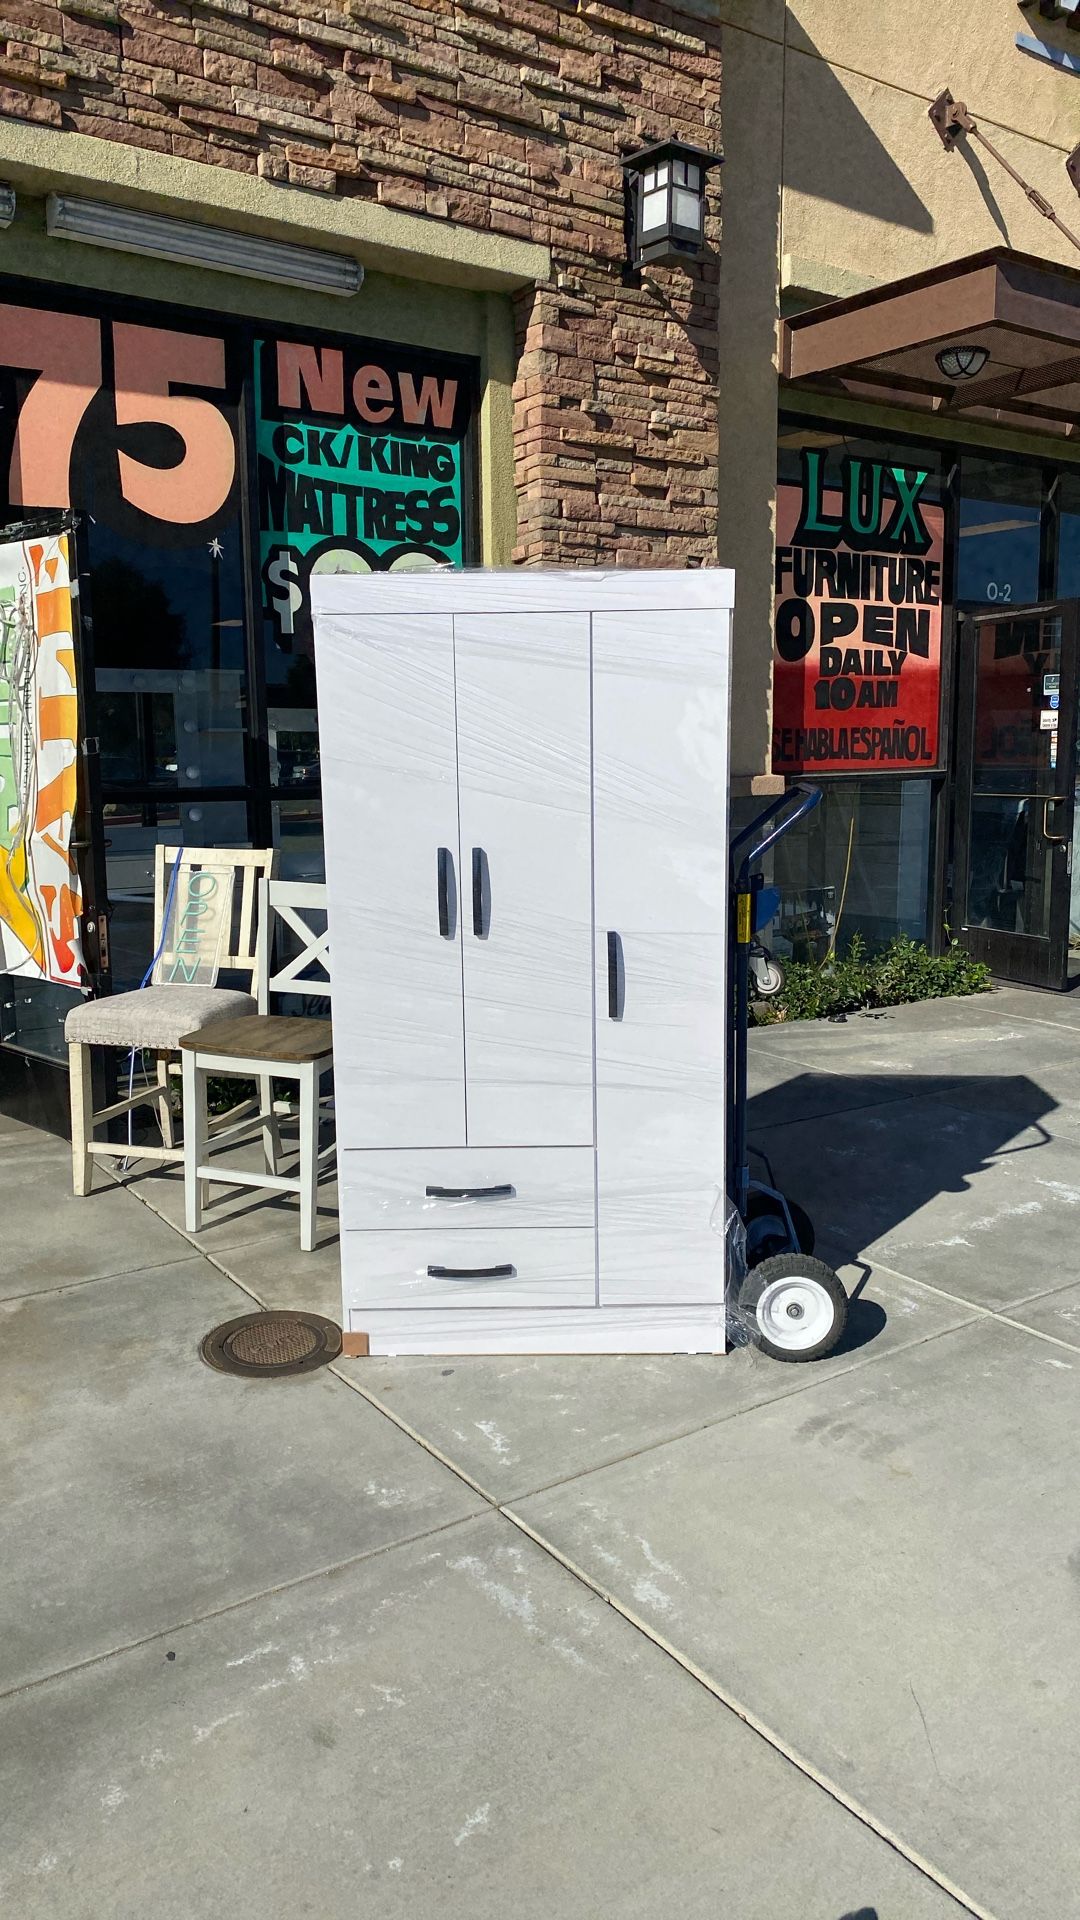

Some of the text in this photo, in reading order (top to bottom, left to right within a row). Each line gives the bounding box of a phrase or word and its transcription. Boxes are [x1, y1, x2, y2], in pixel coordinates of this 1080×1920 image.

[276, 340, 458, 429] New
[258, 453, 461, 547] MATTRESS
[801, 450, 930, 546] LUX
[775, 546, 940, 606] FURNITURE
[775, 598, 931, 662] OPEN
[820, 646, 908, 677] DAILY
[168, 872, 217, 983] OPEN
